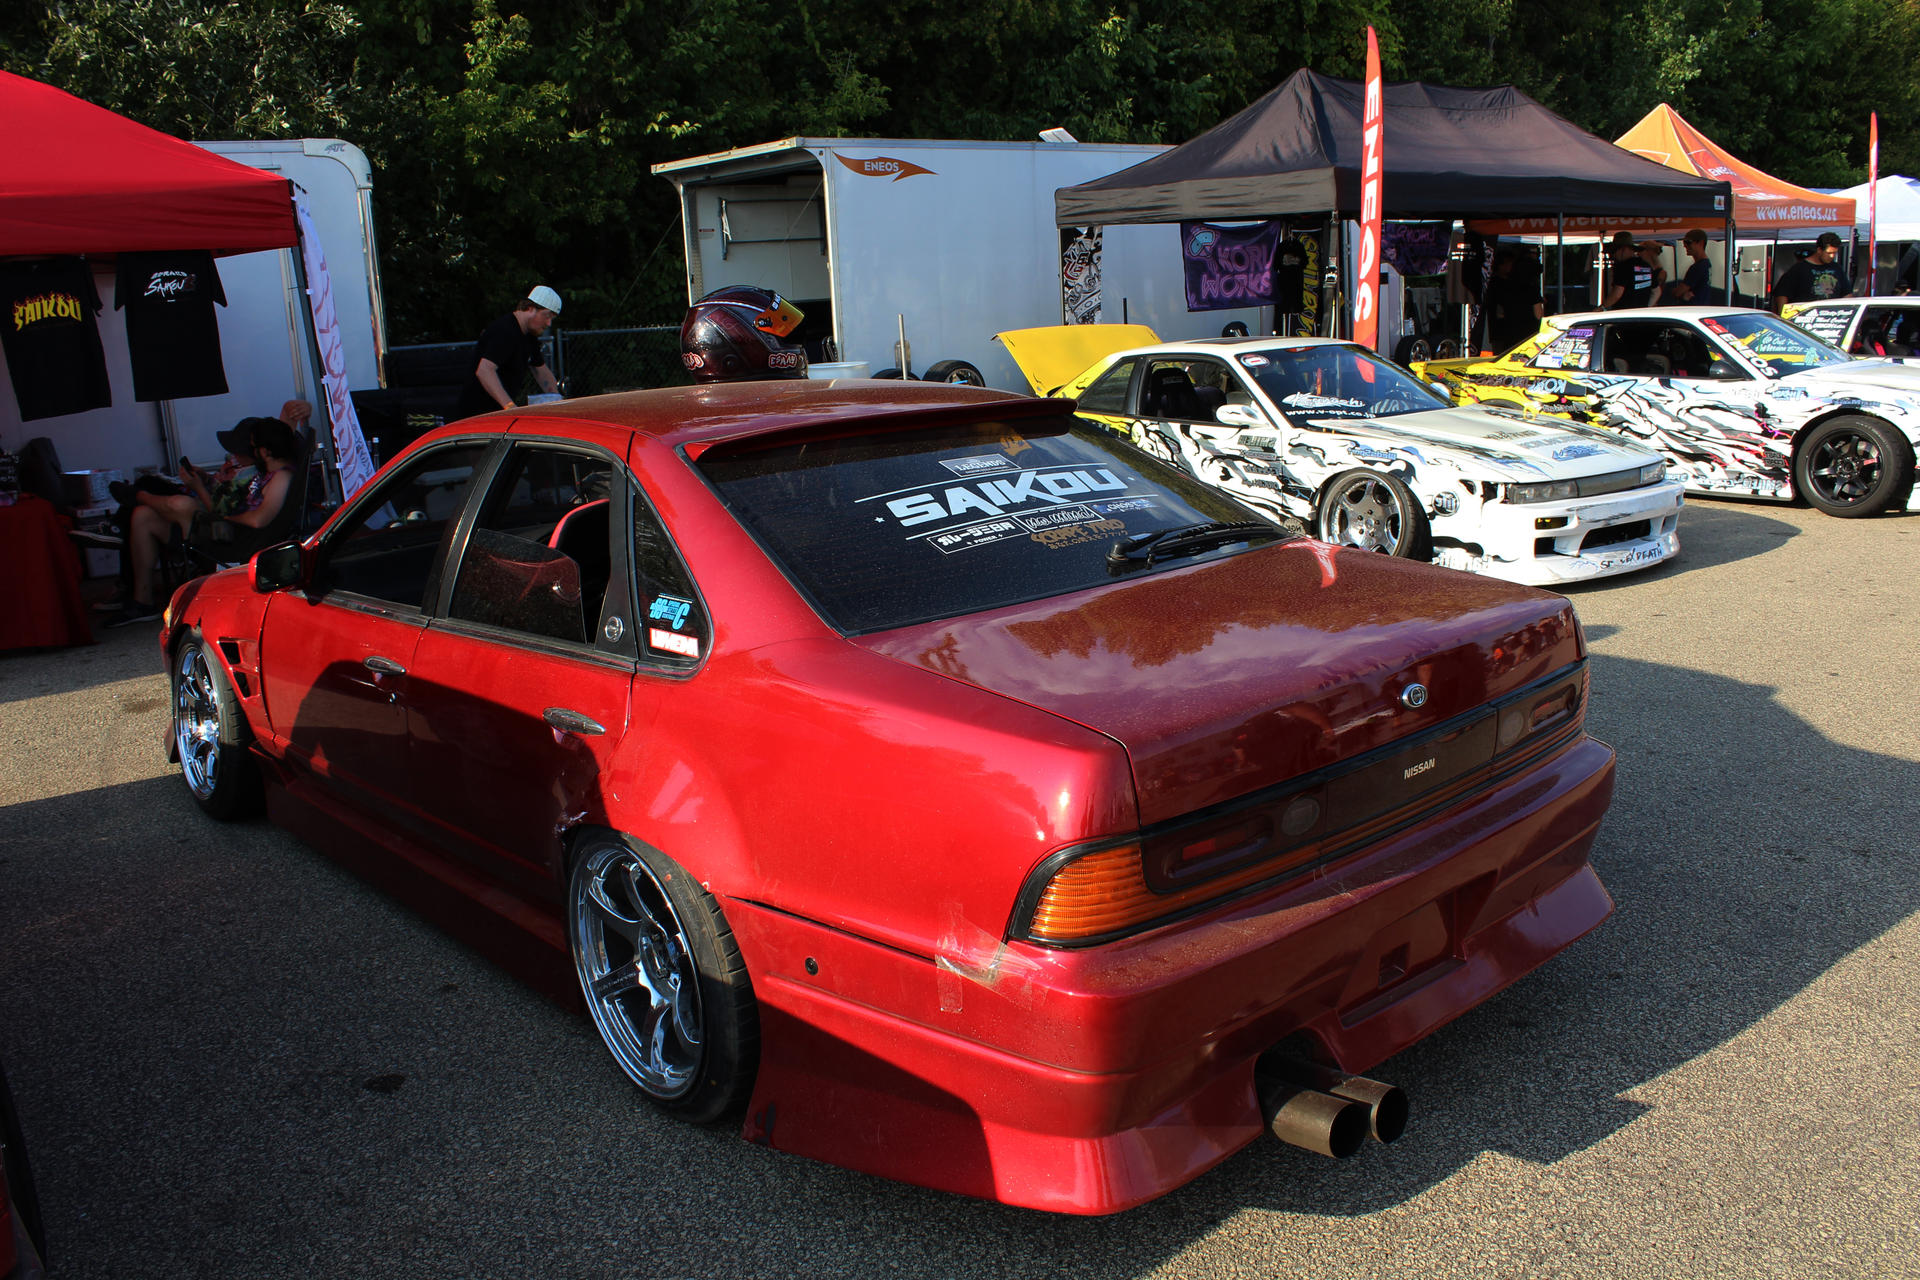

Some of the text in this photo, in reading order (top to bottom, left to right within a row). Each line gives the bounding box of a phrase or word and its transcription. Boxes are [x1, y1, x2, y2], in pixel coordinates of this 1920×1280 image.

[864, 161, 899, 172] ENEOS
[1354, 76, 1380, 322] ENEOS
[1756, 205, 1837, 221] www.eneos.us
[1202, 271, 1273, 298] WORKS
[14, 292, 82, 332] SAIKOU
[1720, 333, 1779, 377] ENEOS
[886, 468, 1128, 527] SAIKOU
[973, 535, 998, 544] POWER
[1403, 757, 1436, 780] NISSAN
